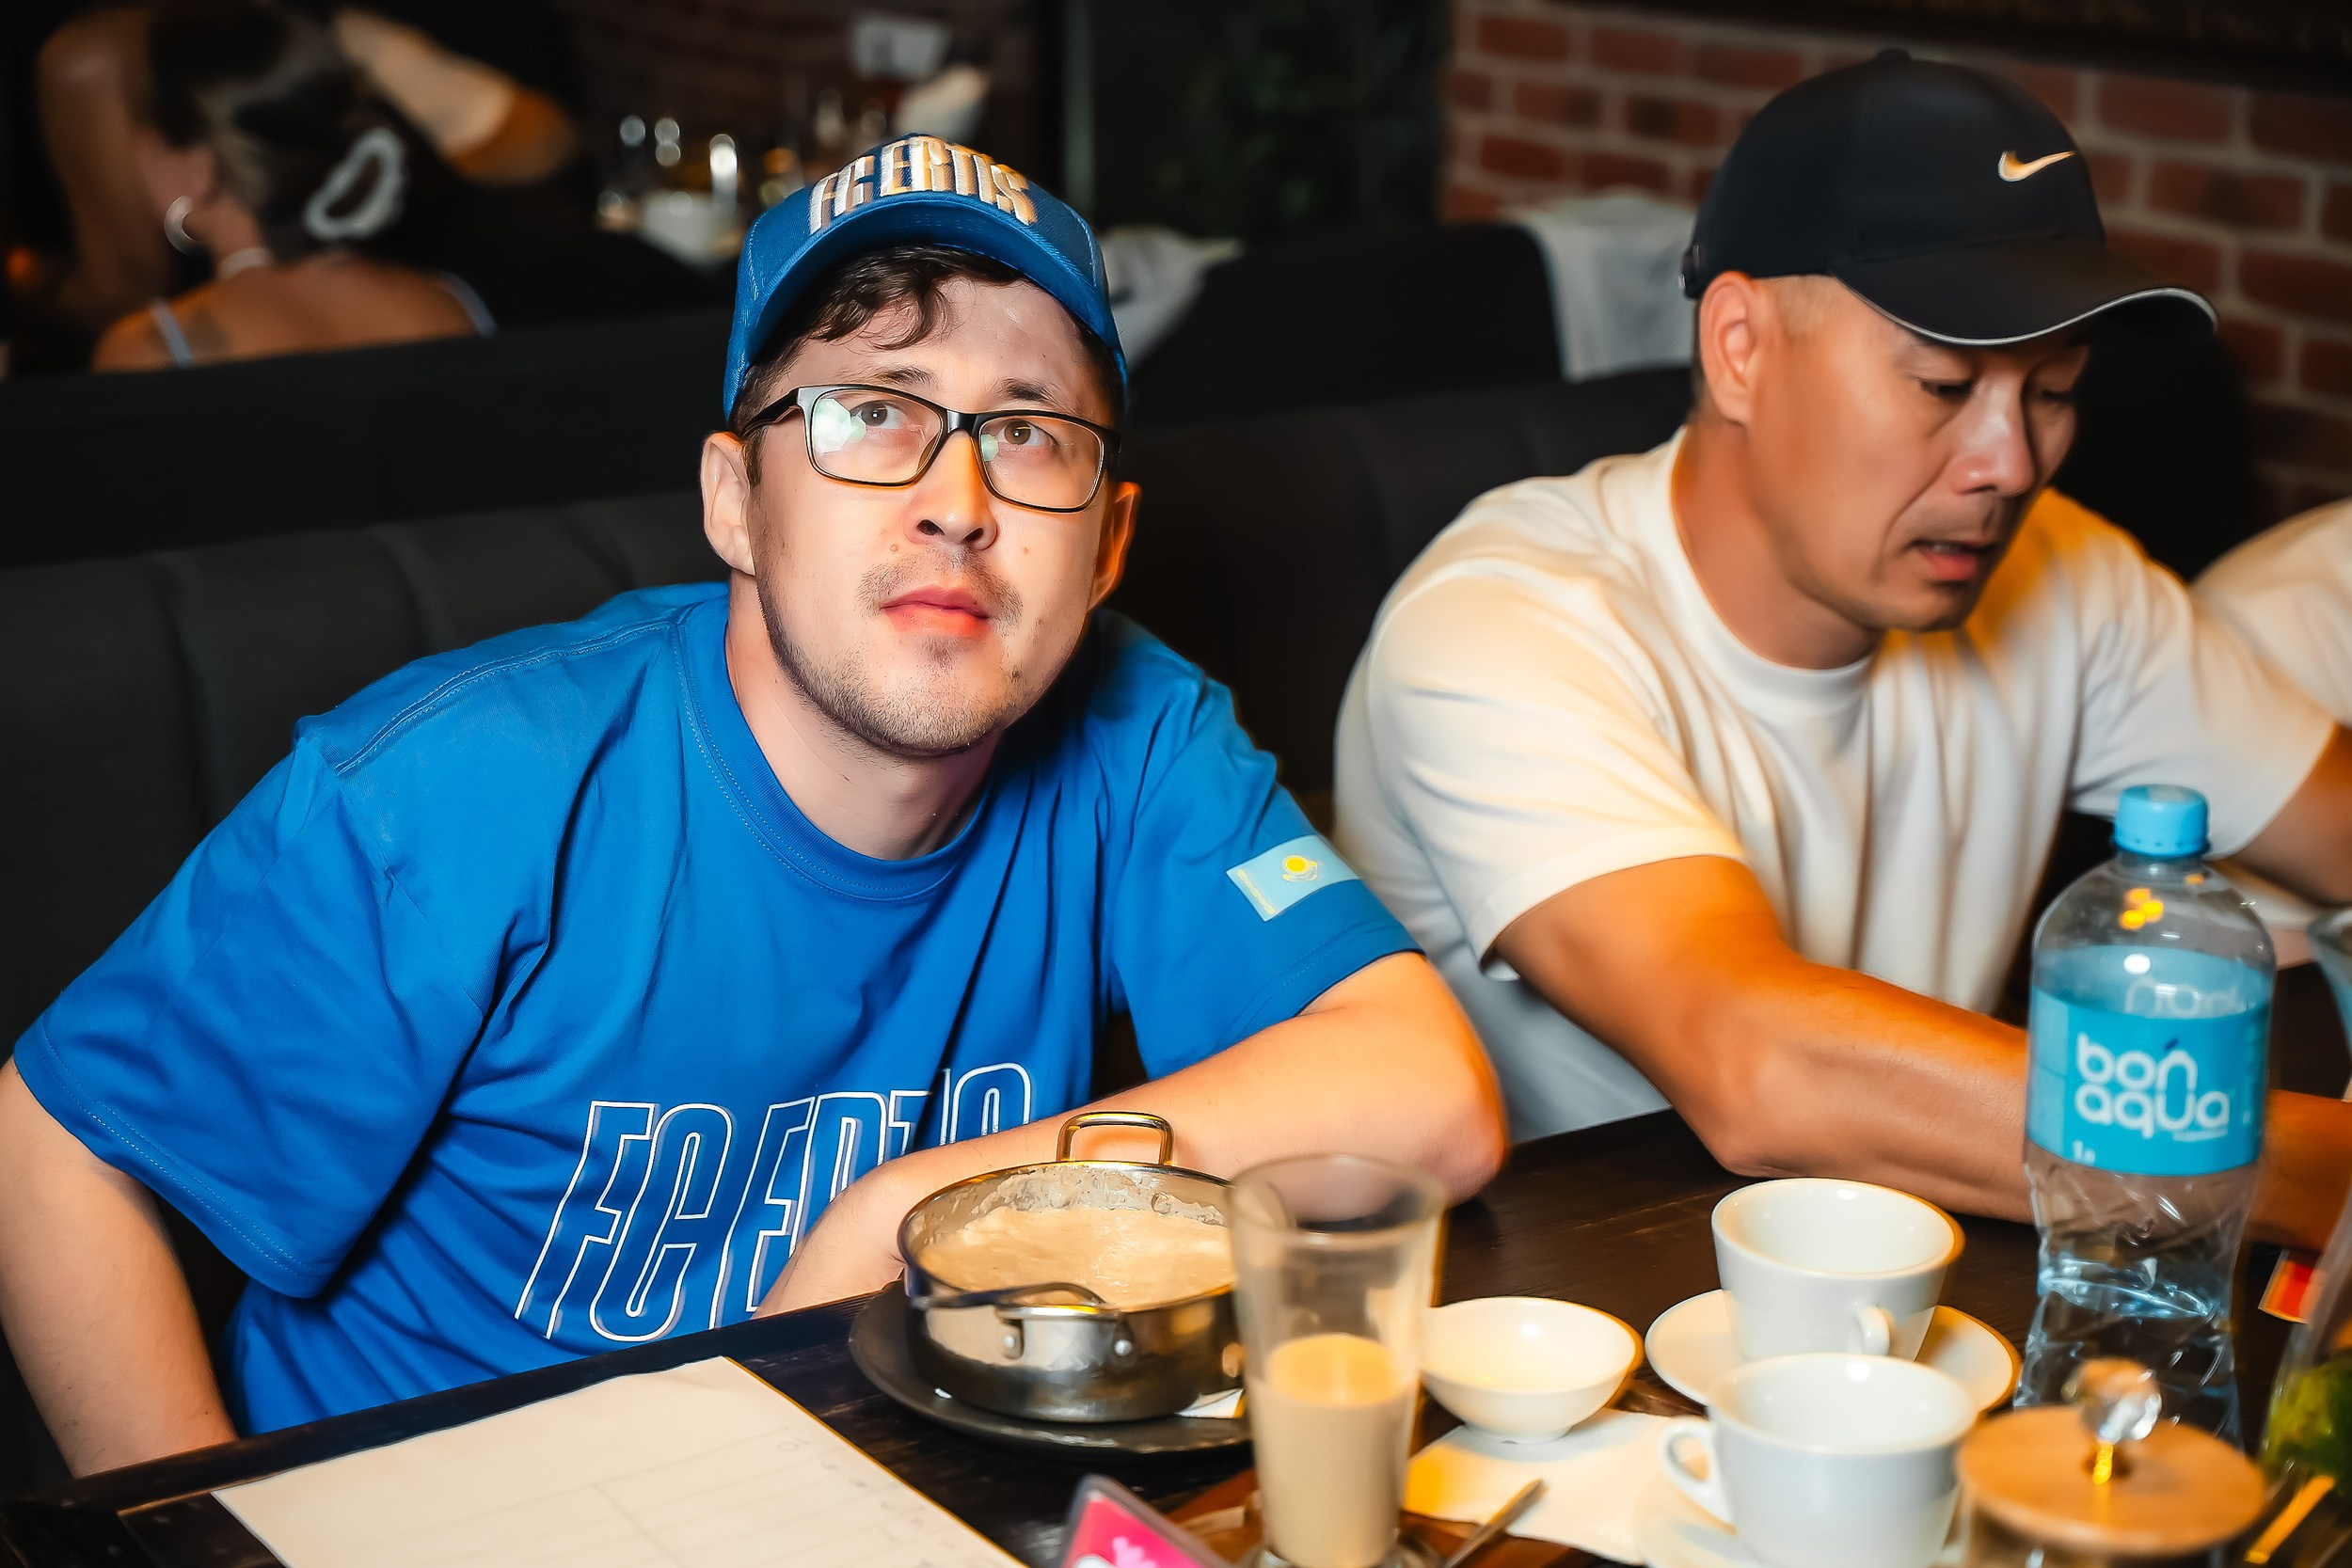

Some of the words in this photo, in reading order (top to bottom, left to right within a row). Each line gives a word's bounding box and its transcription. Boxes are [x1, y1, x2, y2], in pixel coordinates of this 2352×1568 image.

[808, 155, 875, 234] FC
[880, 135, 1037, 226] ERTIS
[2074, 1084, 2231, 1139] aqua
[515, 1100, 738, 1342] FC
